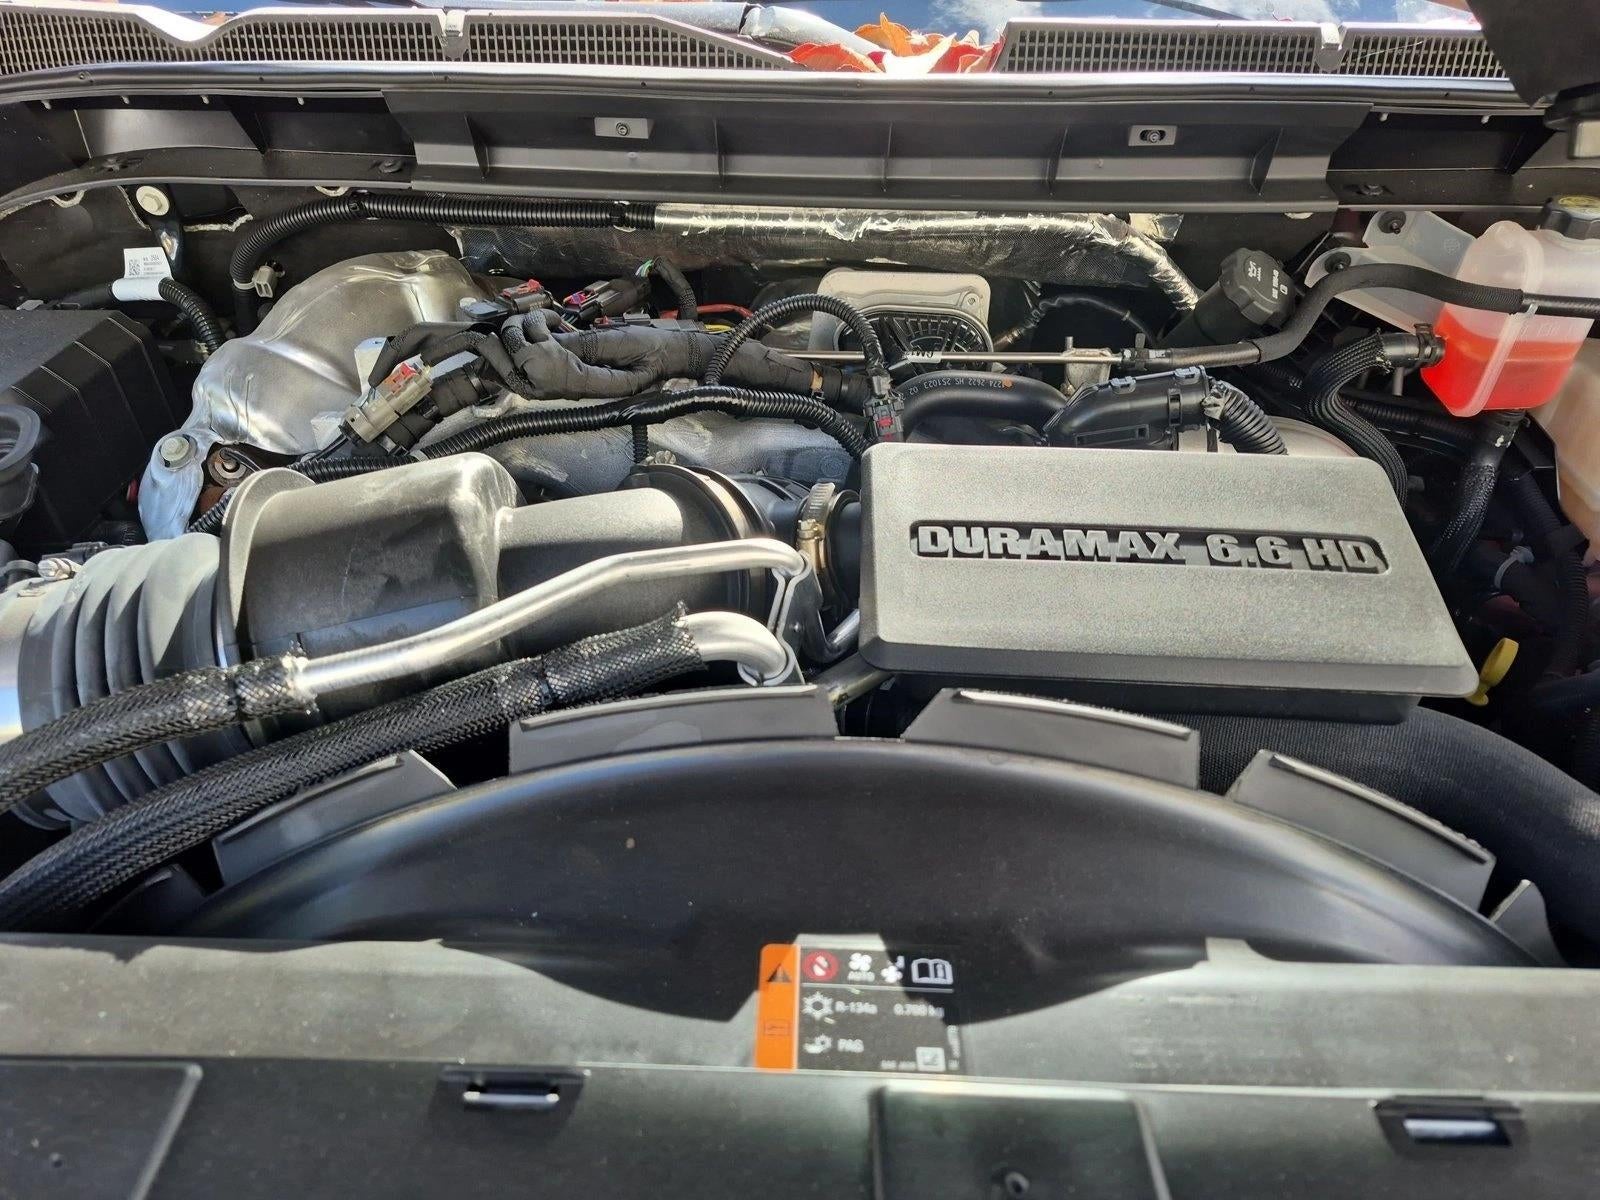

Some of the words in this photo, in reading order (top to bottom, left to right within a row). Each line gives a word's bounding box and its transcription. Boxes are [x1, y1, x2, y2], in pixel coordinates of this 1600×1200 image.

[917, 524, 1185, 564] DURAMAX
[1206, 534, 1293, 568] 6.6
[1303, 537, 1380, 573] HD
